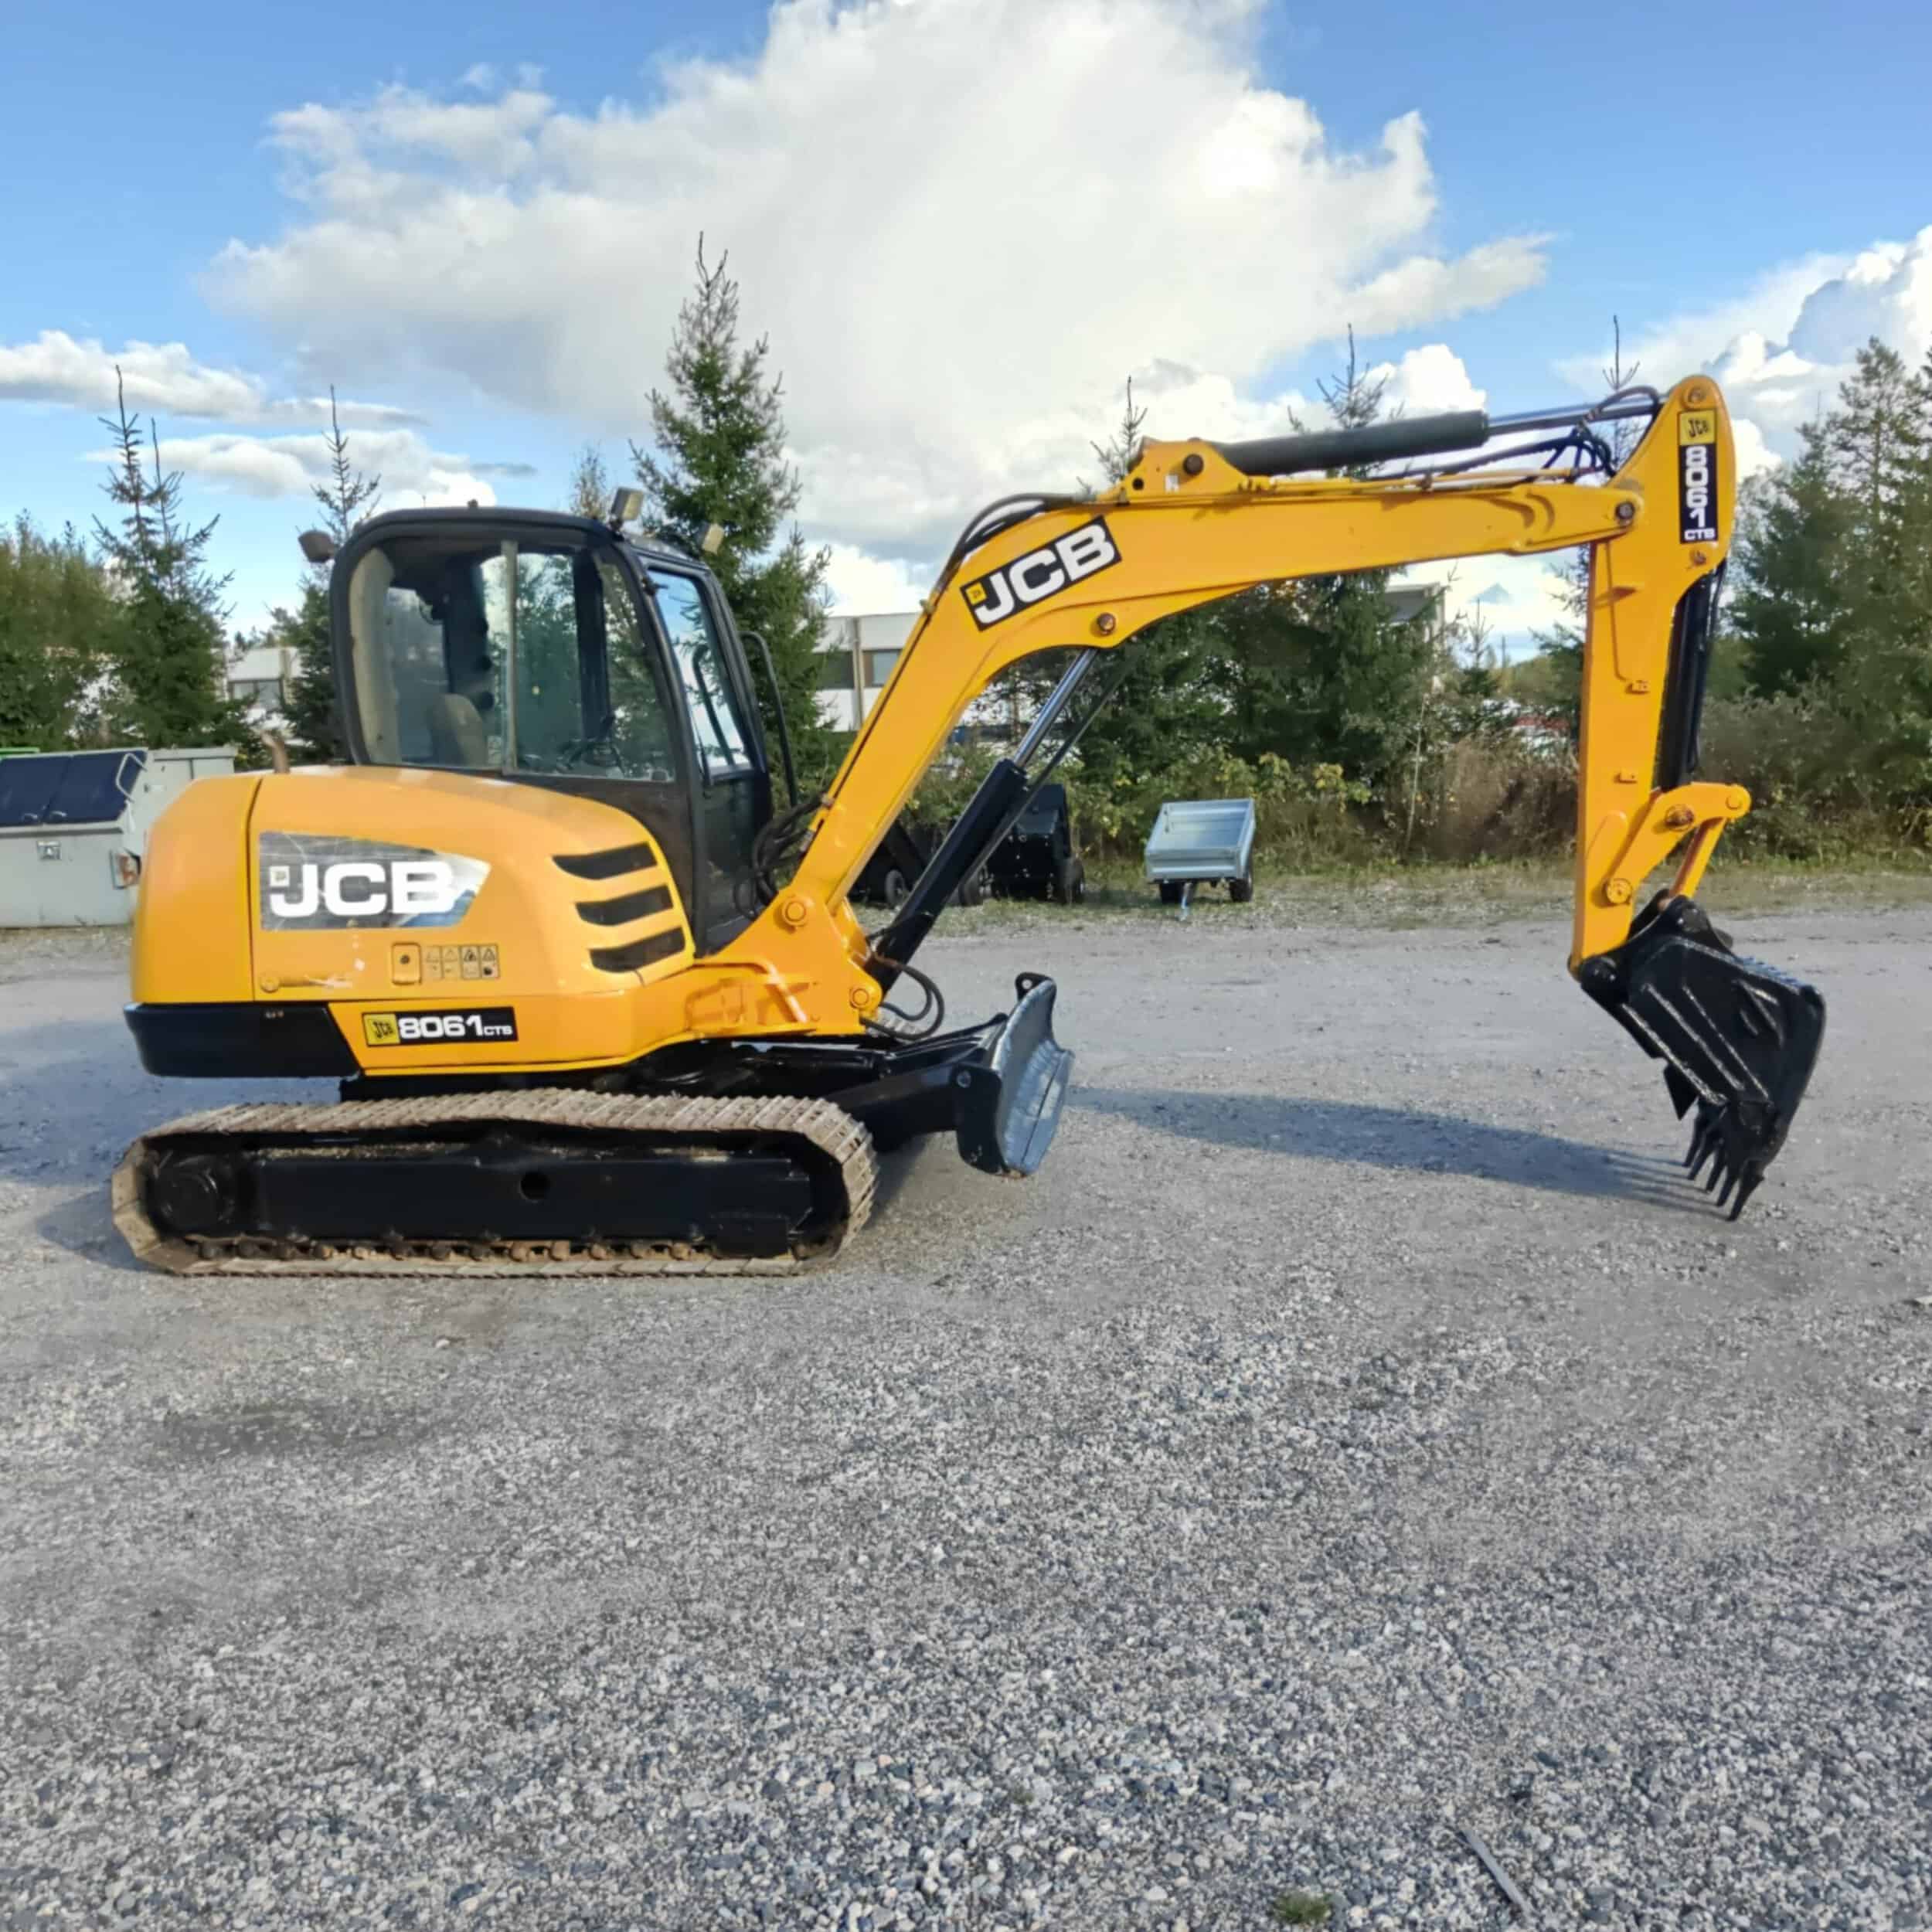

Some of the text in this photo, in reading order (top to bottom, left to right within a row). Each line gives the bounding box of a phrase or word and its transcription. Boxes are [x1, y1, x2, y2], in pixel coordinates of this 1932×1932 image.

[1685, 445, 1709, 528] 8061
[975, 524, 1115, 624] JCB
[269, 861, 454, 917] JCB
